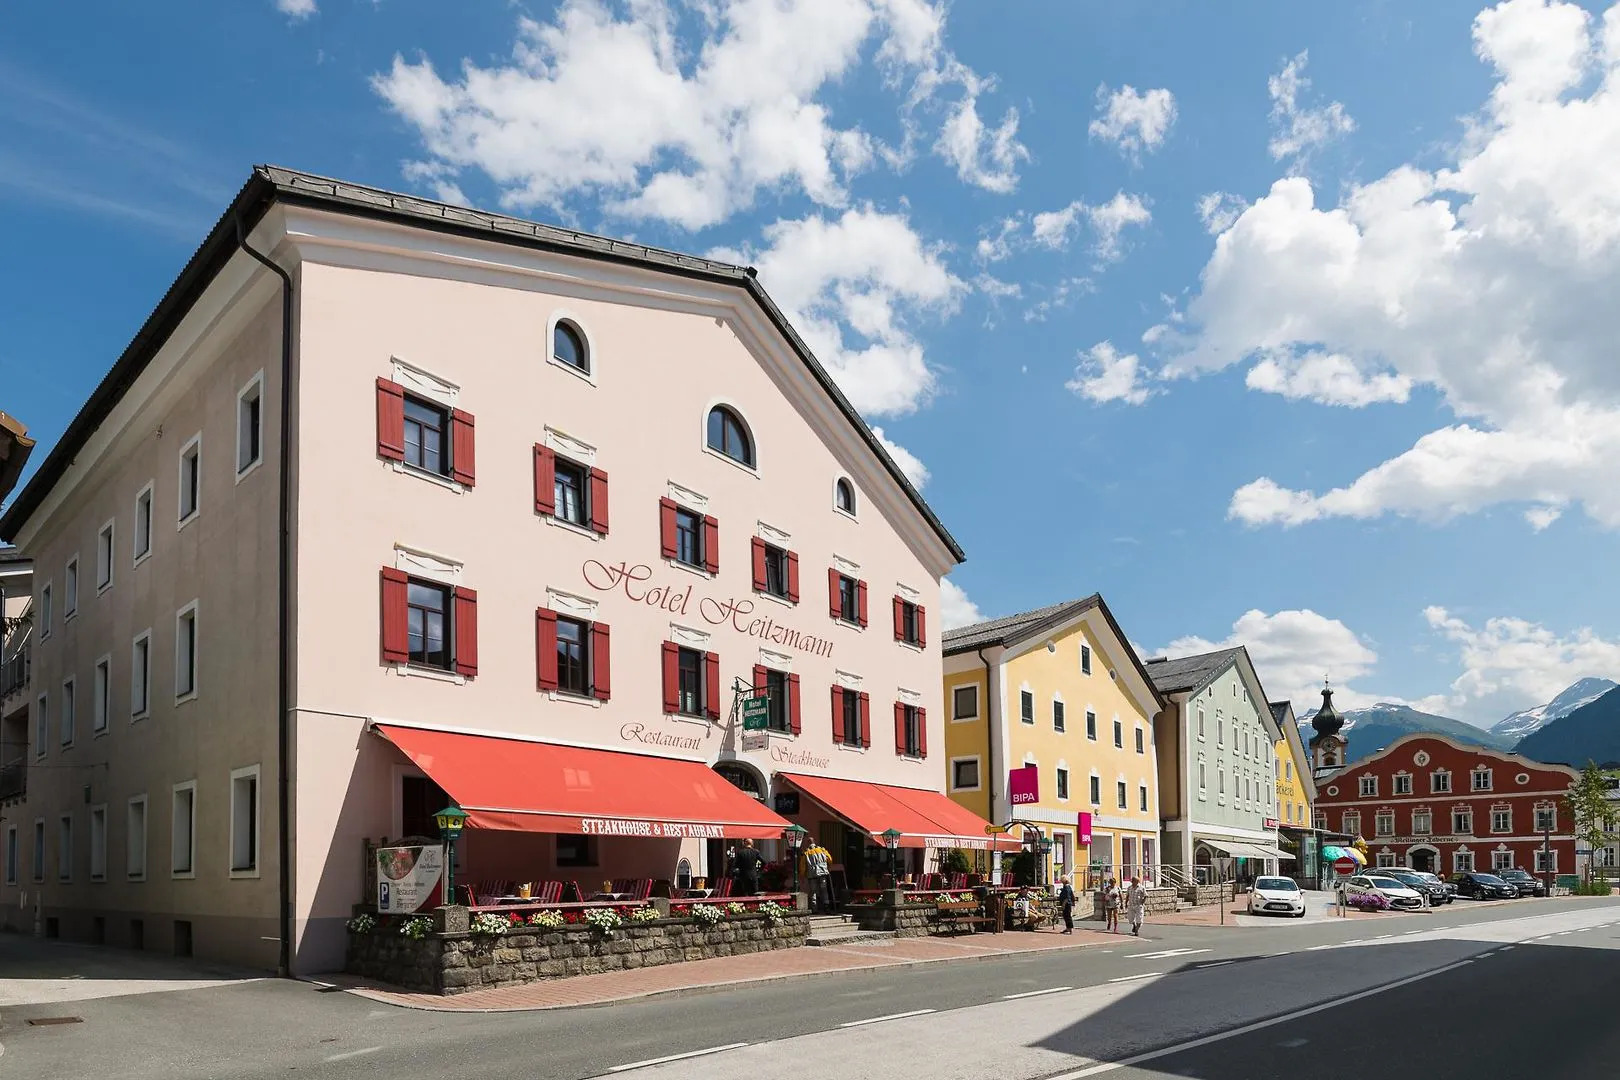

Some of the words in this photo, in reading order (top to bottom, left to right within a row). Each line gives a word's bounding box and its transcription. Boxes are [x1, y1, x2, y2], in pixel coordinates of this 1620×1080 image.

[582, 559, 692, 615] Hotel
[699, 597, 834, 658] Heitzmann
[748, 700, 762, 708] Hotel
[620, 722, 703, 750] Restaurant
[770, 745, 831, 769] Steakhouse
[1013, 792, 1035, 803] BIPA
[581, 818, 652, 836] STEAKHOUSE
[653, 823, 661, 835] &
[663, 823, 725, 838] RESTAURANT
[1082, 834, 1091, 842] BIPA
[381, 883, 388, 901] P
